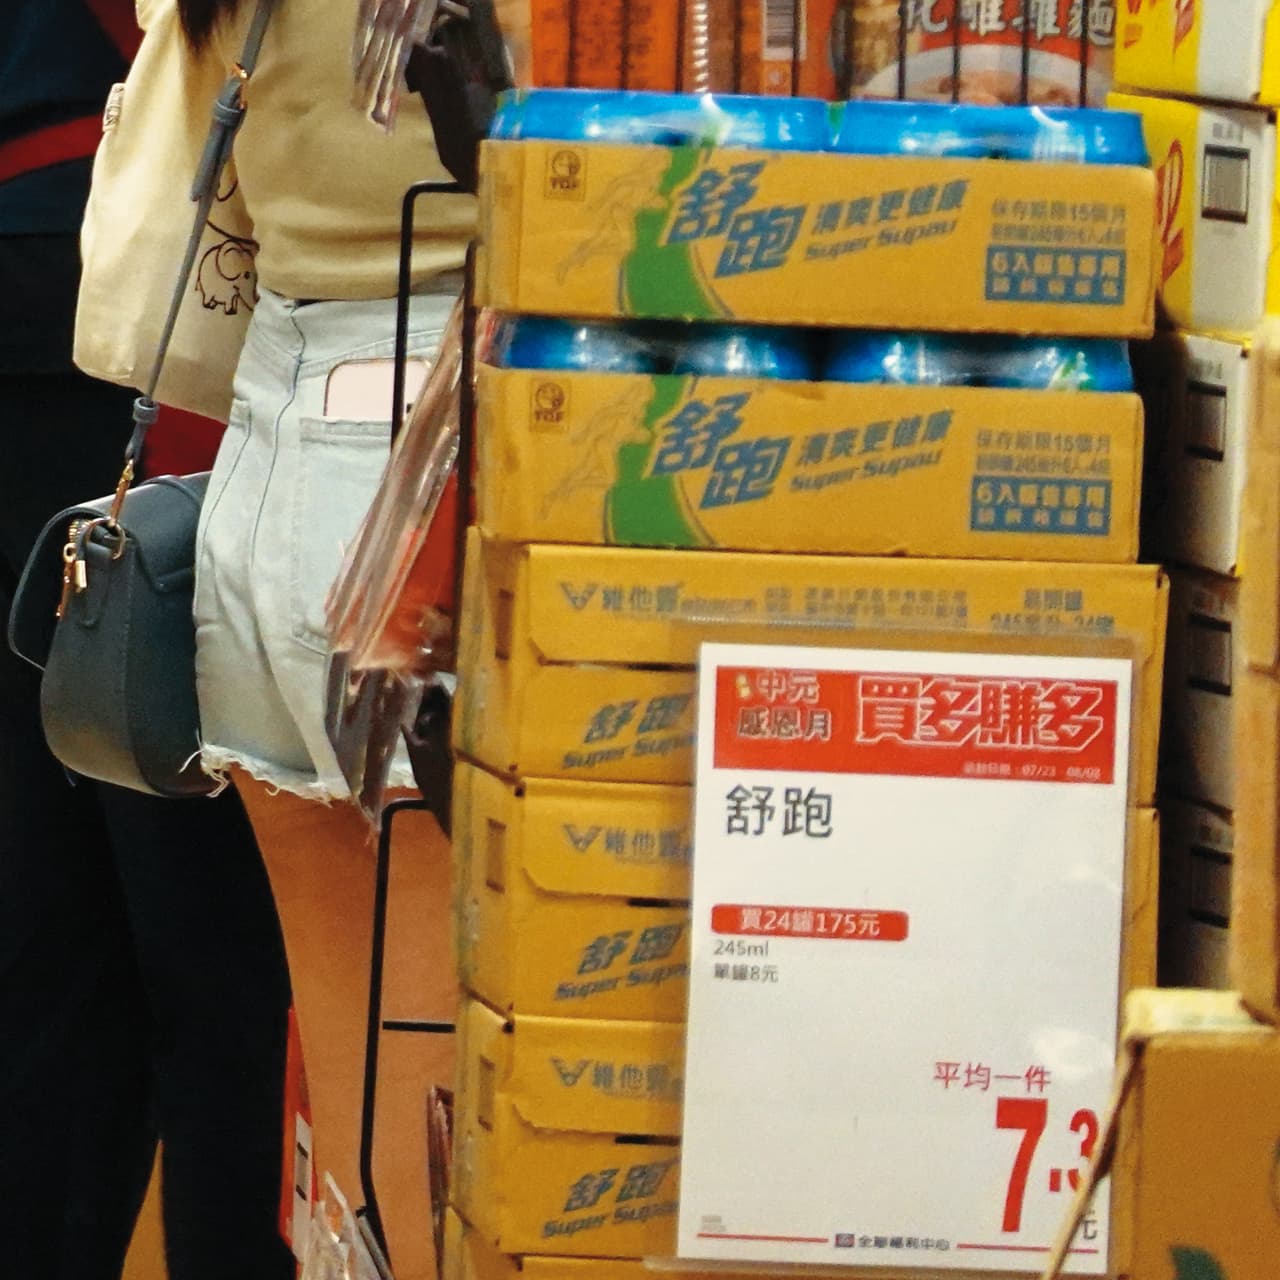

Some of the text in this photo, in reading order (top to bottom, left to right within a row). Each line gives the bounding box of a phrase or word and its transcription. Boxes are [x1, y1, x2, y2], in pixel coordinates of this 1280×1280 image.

[665, 159, 810, 280] 舒跑
[804, 234, 871, 261] Super
[650, 390, 794, 510] 舒跑
[788, 466, 860, 493] Super
[756, 670, 821, 705] 中元
[736, 706, 833, 742] 感恩月
[855, 675, 1104, 752] 買多賺多
[724, 783, 834, 839] 舒跑
[741, 907, 881, 937] 買24罐175元
[713, 939, 769, 958] 245ml
[713, 962, 779, 984] 單罐8元
[933, 1060, 1052, 1094] 平均一件
[857, 1234, 951, 1252] 全聯福利中心
